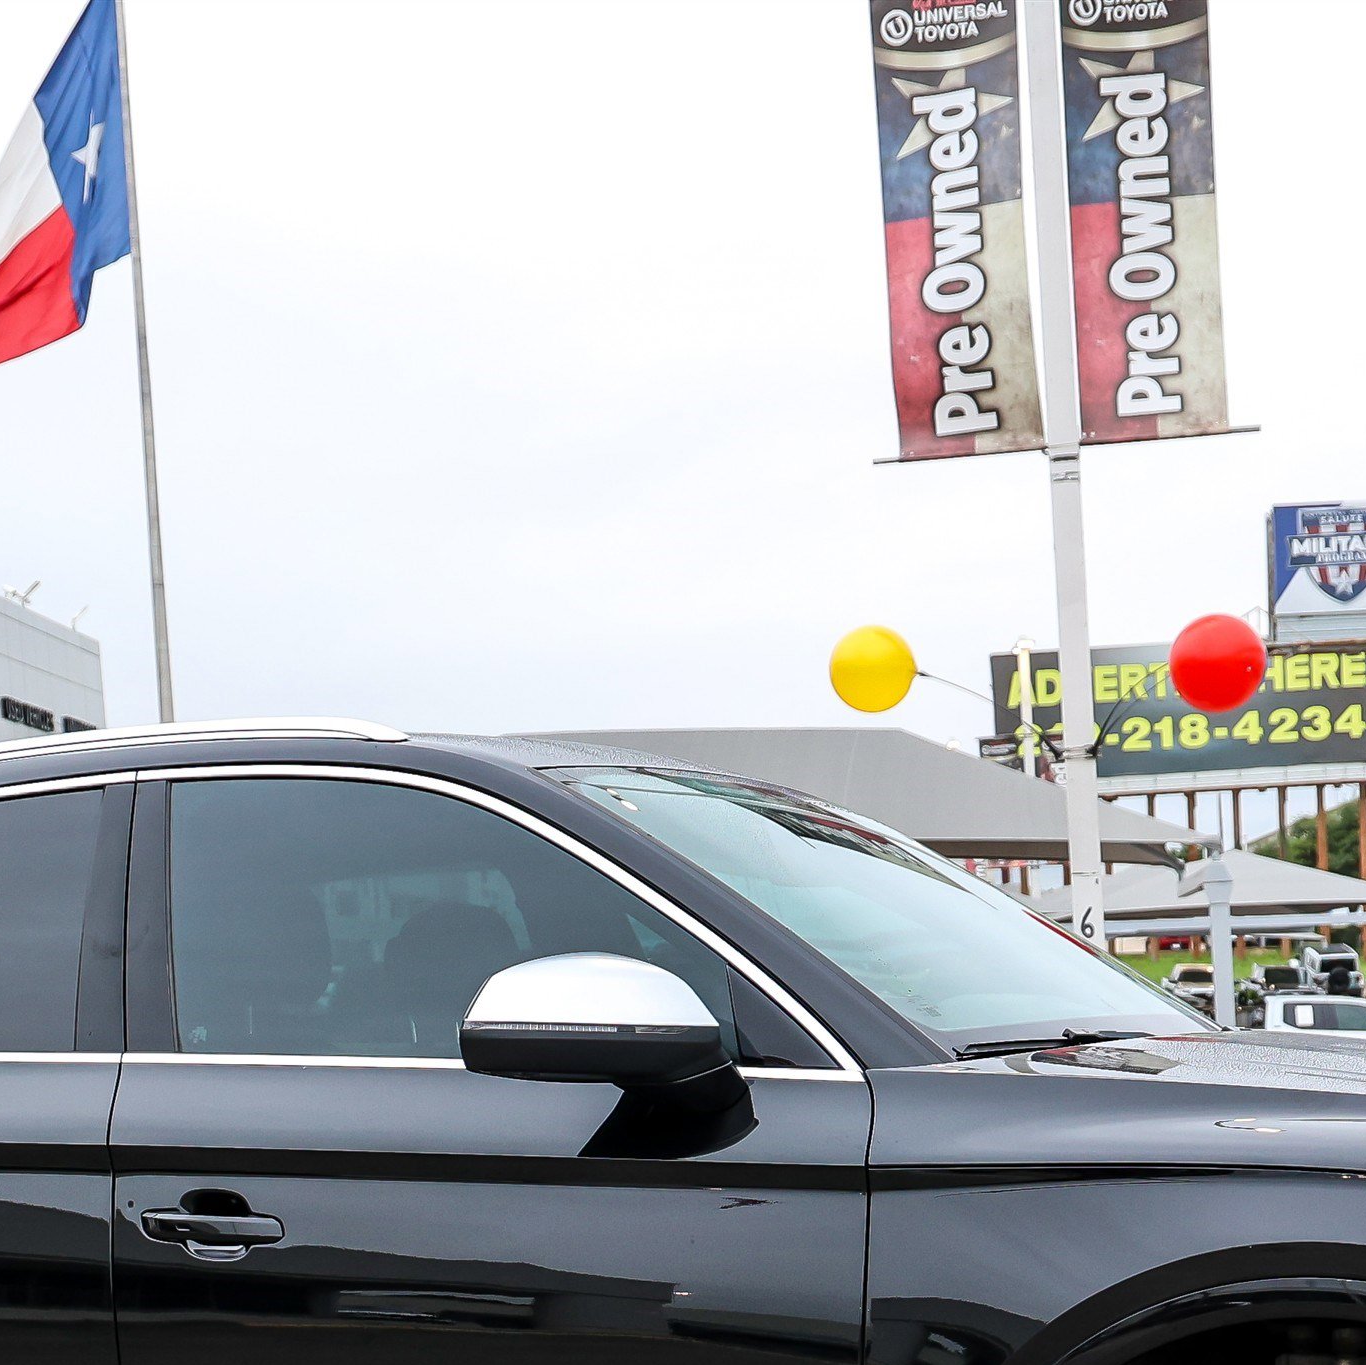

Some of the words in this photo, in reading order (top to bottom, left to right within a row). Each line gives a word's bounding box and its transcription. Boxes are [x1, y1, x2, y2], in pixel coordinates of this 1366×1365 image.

[914, 1, 1008, 26] UNIVERSAL
[1103, 1, 1169, 24] TOYOTA
[914, 20, 979, 43] TOYOTA
[912, 87, 985, 313] Owned
[1098, 72, 1177, 301] Owned
[934, 323, 1001, 437] Pre
[1116, 312, 1185, 417] Pre
[1320, 513, 1363, 523] SALUTE
[1081, 906, 1095, 938] 6
